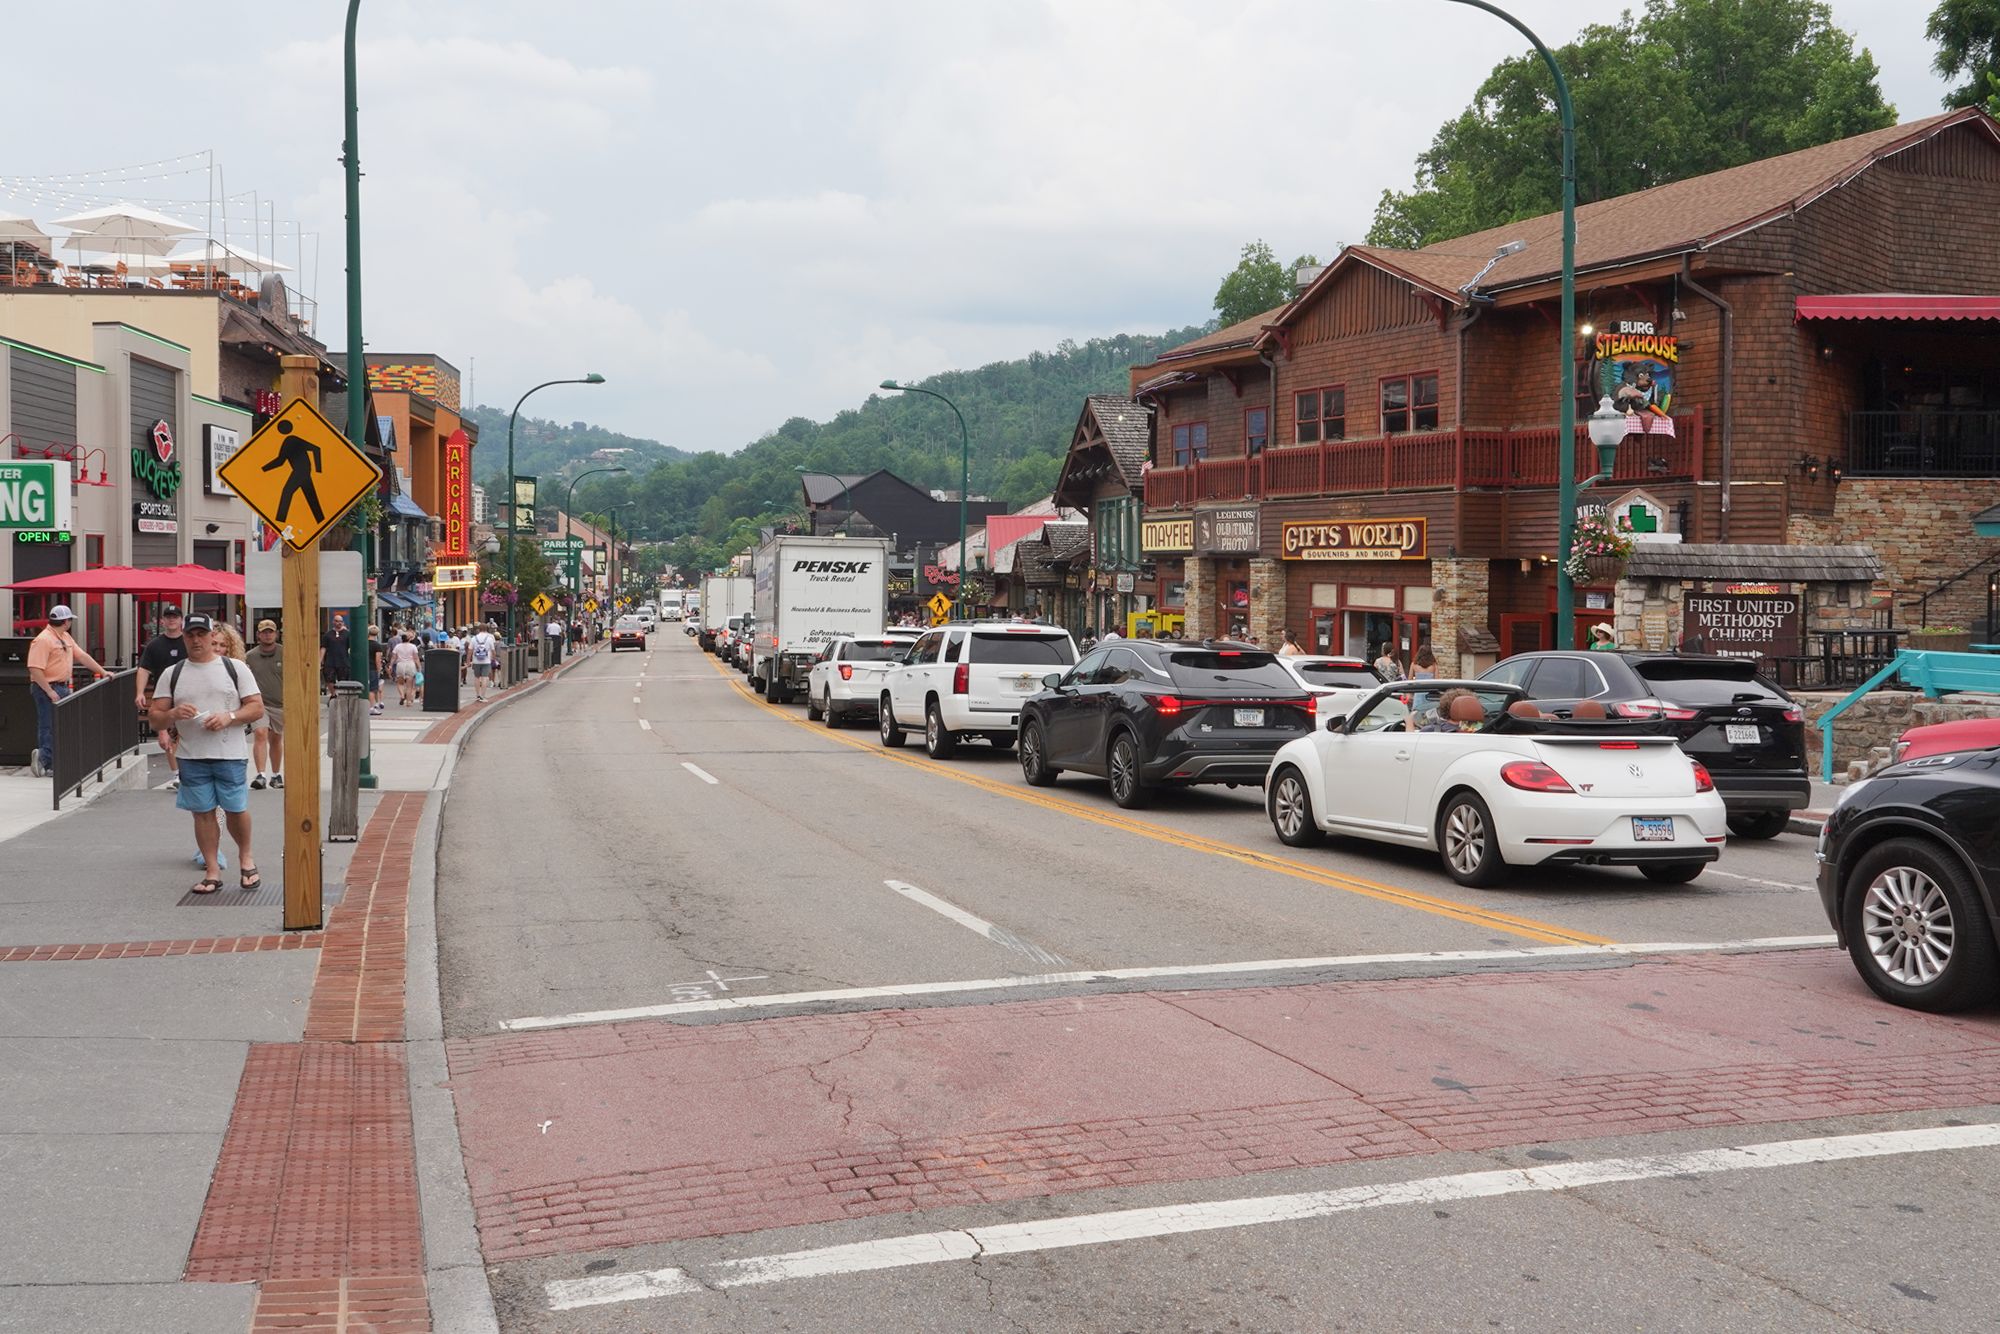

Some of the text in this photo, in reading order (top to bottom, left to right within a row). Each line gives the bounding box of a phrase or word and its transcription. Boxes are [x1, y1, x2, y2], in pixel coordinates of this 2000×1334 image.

[1620, 321, 1654, 334] BURG
[1596, 332, 1679, 363] STEAKHOUSE
[132, 448, 183, 500] PUCKERS
[0, 480, 46, 523] NG
[450, 449, 460, 550] ARCADE
[140, 502, 161, 516] SPORTS
[1216, 510, 1254, 520] LEGENDS
[1216, 522, 1254, 536] OLD TIME
[19, 532, 50, 542] OPEN
[1221, 537, 1248, 551] PHOTO
[1285, 523, 1418, 552] GIFTS WORLD
[543, 541, 584, 549] PARKNG
[792, 560, 872, 574] PENSKE
[1689, 599, 1795, 613] FIRST UNITED
[1699, 613, 1784, 628] METHODIST
[1709, 627, 1773, 642] CHURCH
[1648, 824, 1672, 836] 53596
